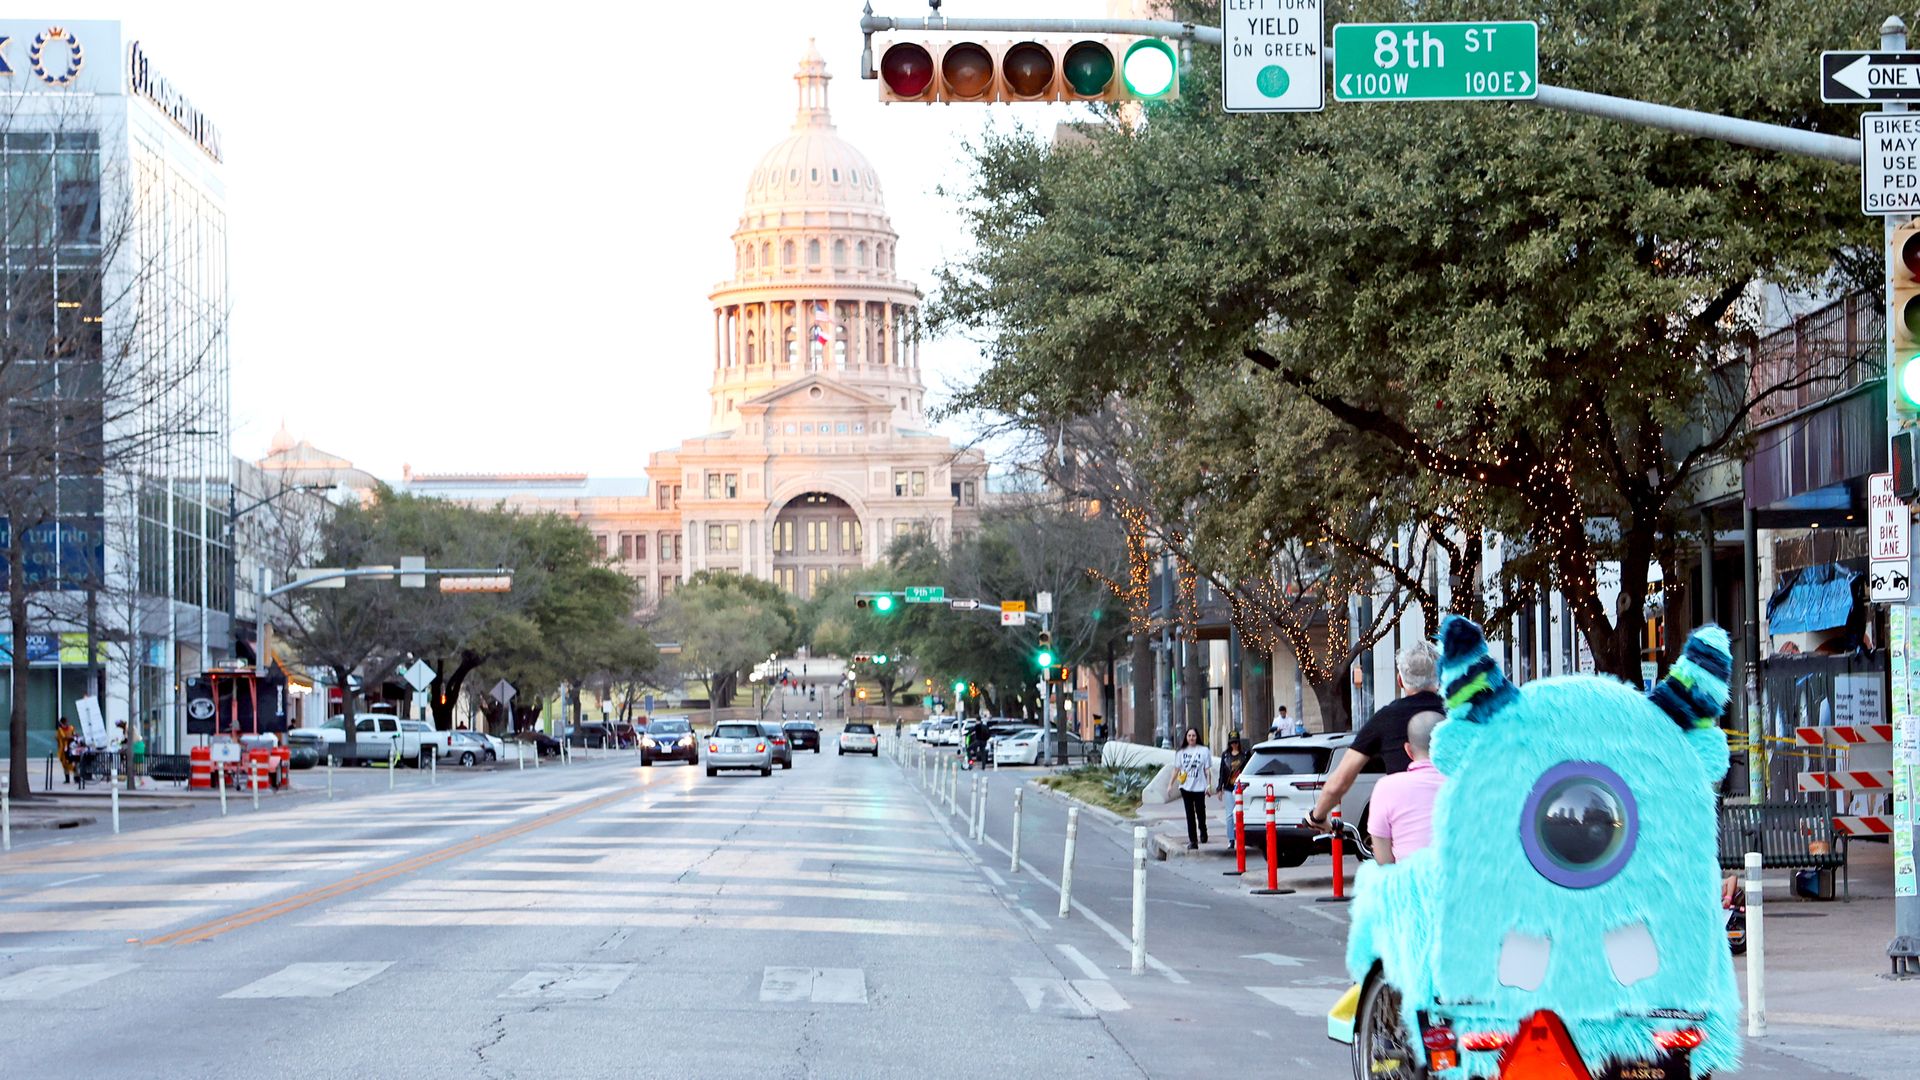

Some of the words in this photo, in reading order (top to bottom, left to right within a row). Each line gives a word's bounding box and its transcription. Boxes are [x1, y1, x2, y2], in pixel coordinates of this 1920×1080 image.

[1230, 0, 1265, 10] LEFT
[1277, 0, 1316, 10] TURN
[1248, 18, 1299, 36] YIELD
[1233, 43, 1252, 57] ON
[1264, 43, 1313, 57] GREEN
[1373, 29, 1445, 69] 8th
[1464, 28, 1497, 53] ST
[1356, 73, 1409, 95] 100W
[1464, 71, 1515, 94] 100E
[1868, 68, 1907, 85] ONE
[1874, 120, 1920, 134] BIKES
[1881, 138, 1918, 152] MAY
[1883, 156, 1917, 170] USE
[1884, 175, 1917, 188] PED
[1872, 495, 1902, 508] PARKIN
[1885, 510, 1894, 523] IN
[1880, 525, 1898, 540] BIKE
[1880, 541, 1899, 555] LANE
[914, 588, 927, 597] 9th
